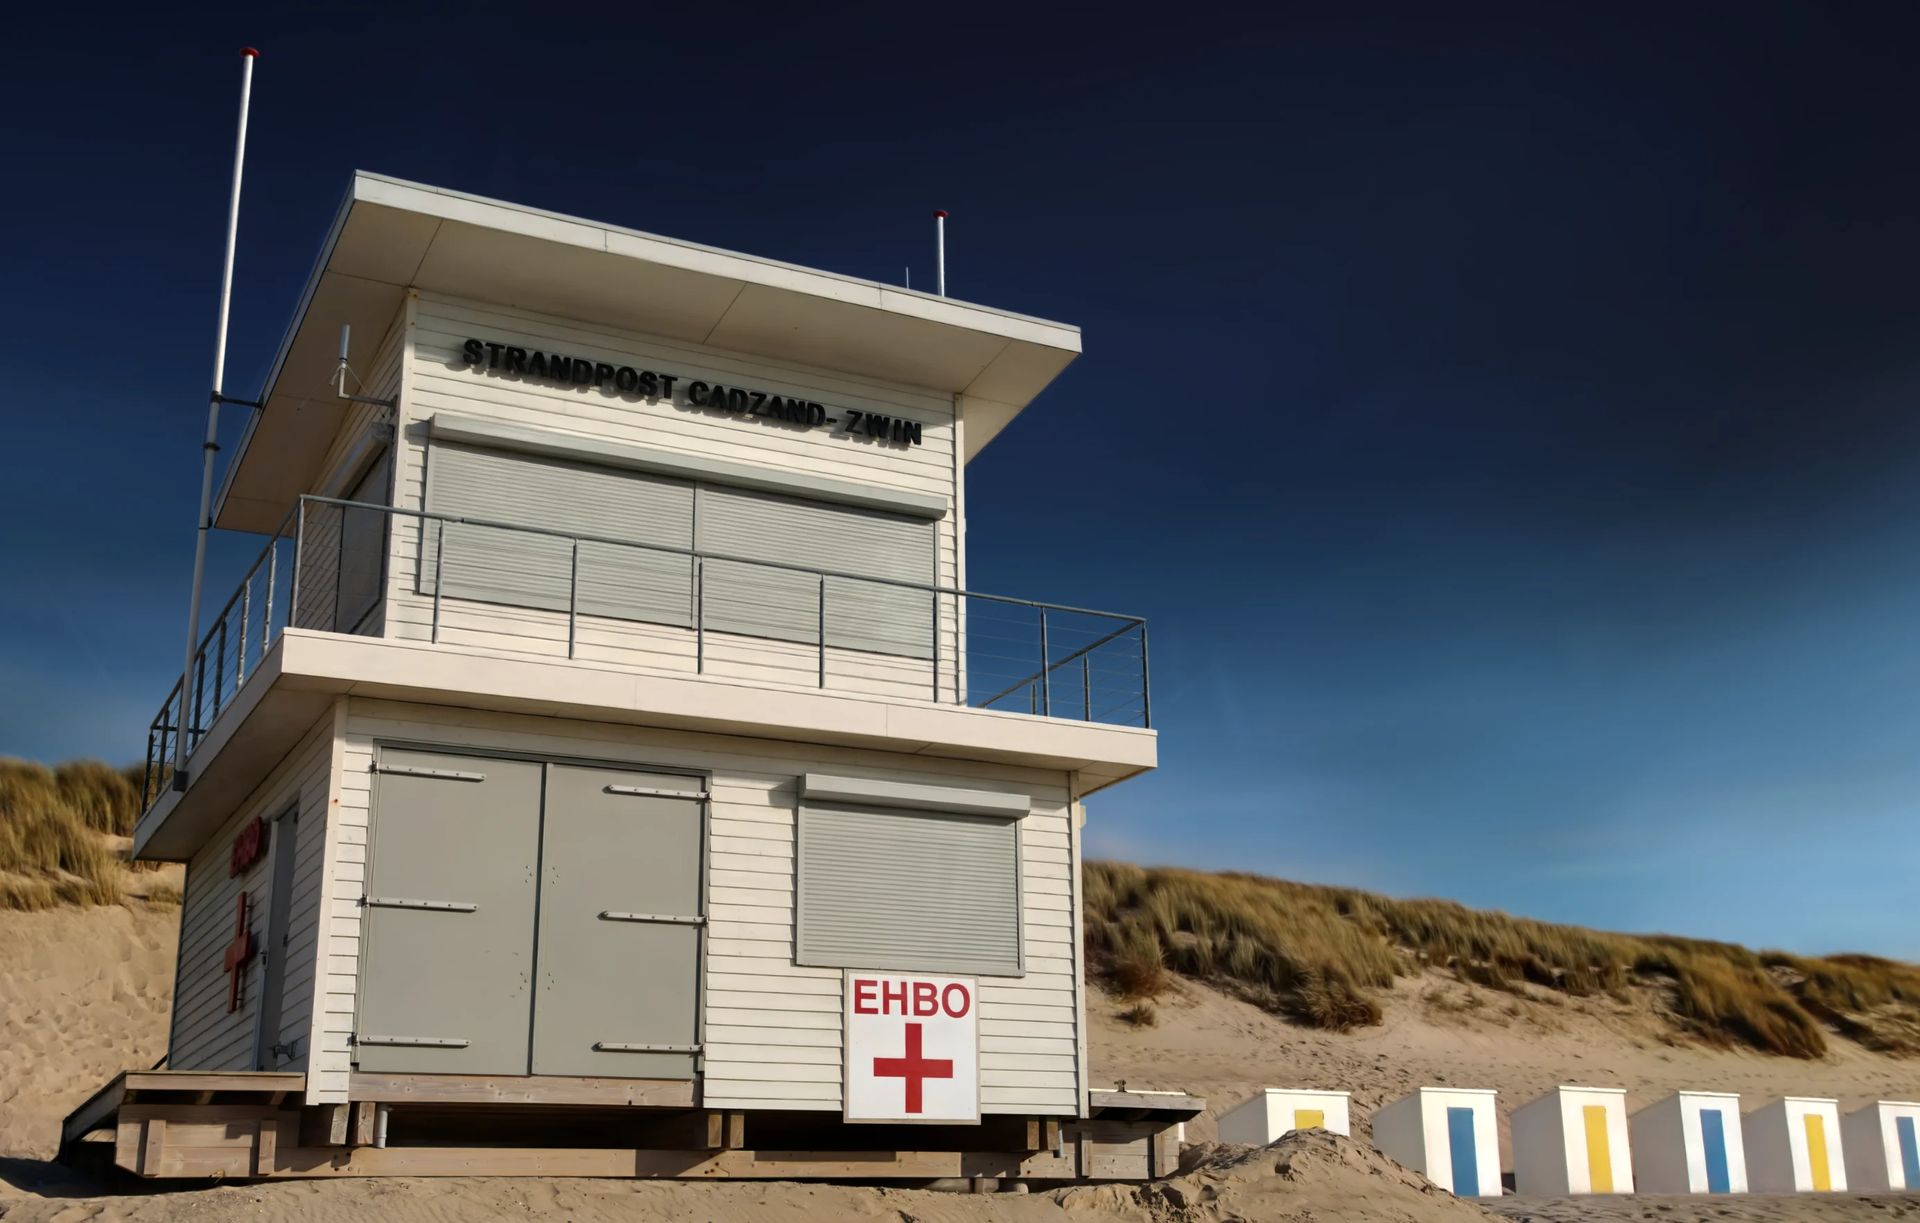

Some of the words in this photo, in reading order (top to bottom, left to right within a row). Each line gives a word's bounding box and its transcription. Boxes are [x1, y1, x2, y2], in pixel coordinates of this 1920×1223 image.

[463, 338, 678, 400] STRANDPOST
[845, 410, 922, 446] ZWIN
[854, 979, 971, 1019] EHBO
